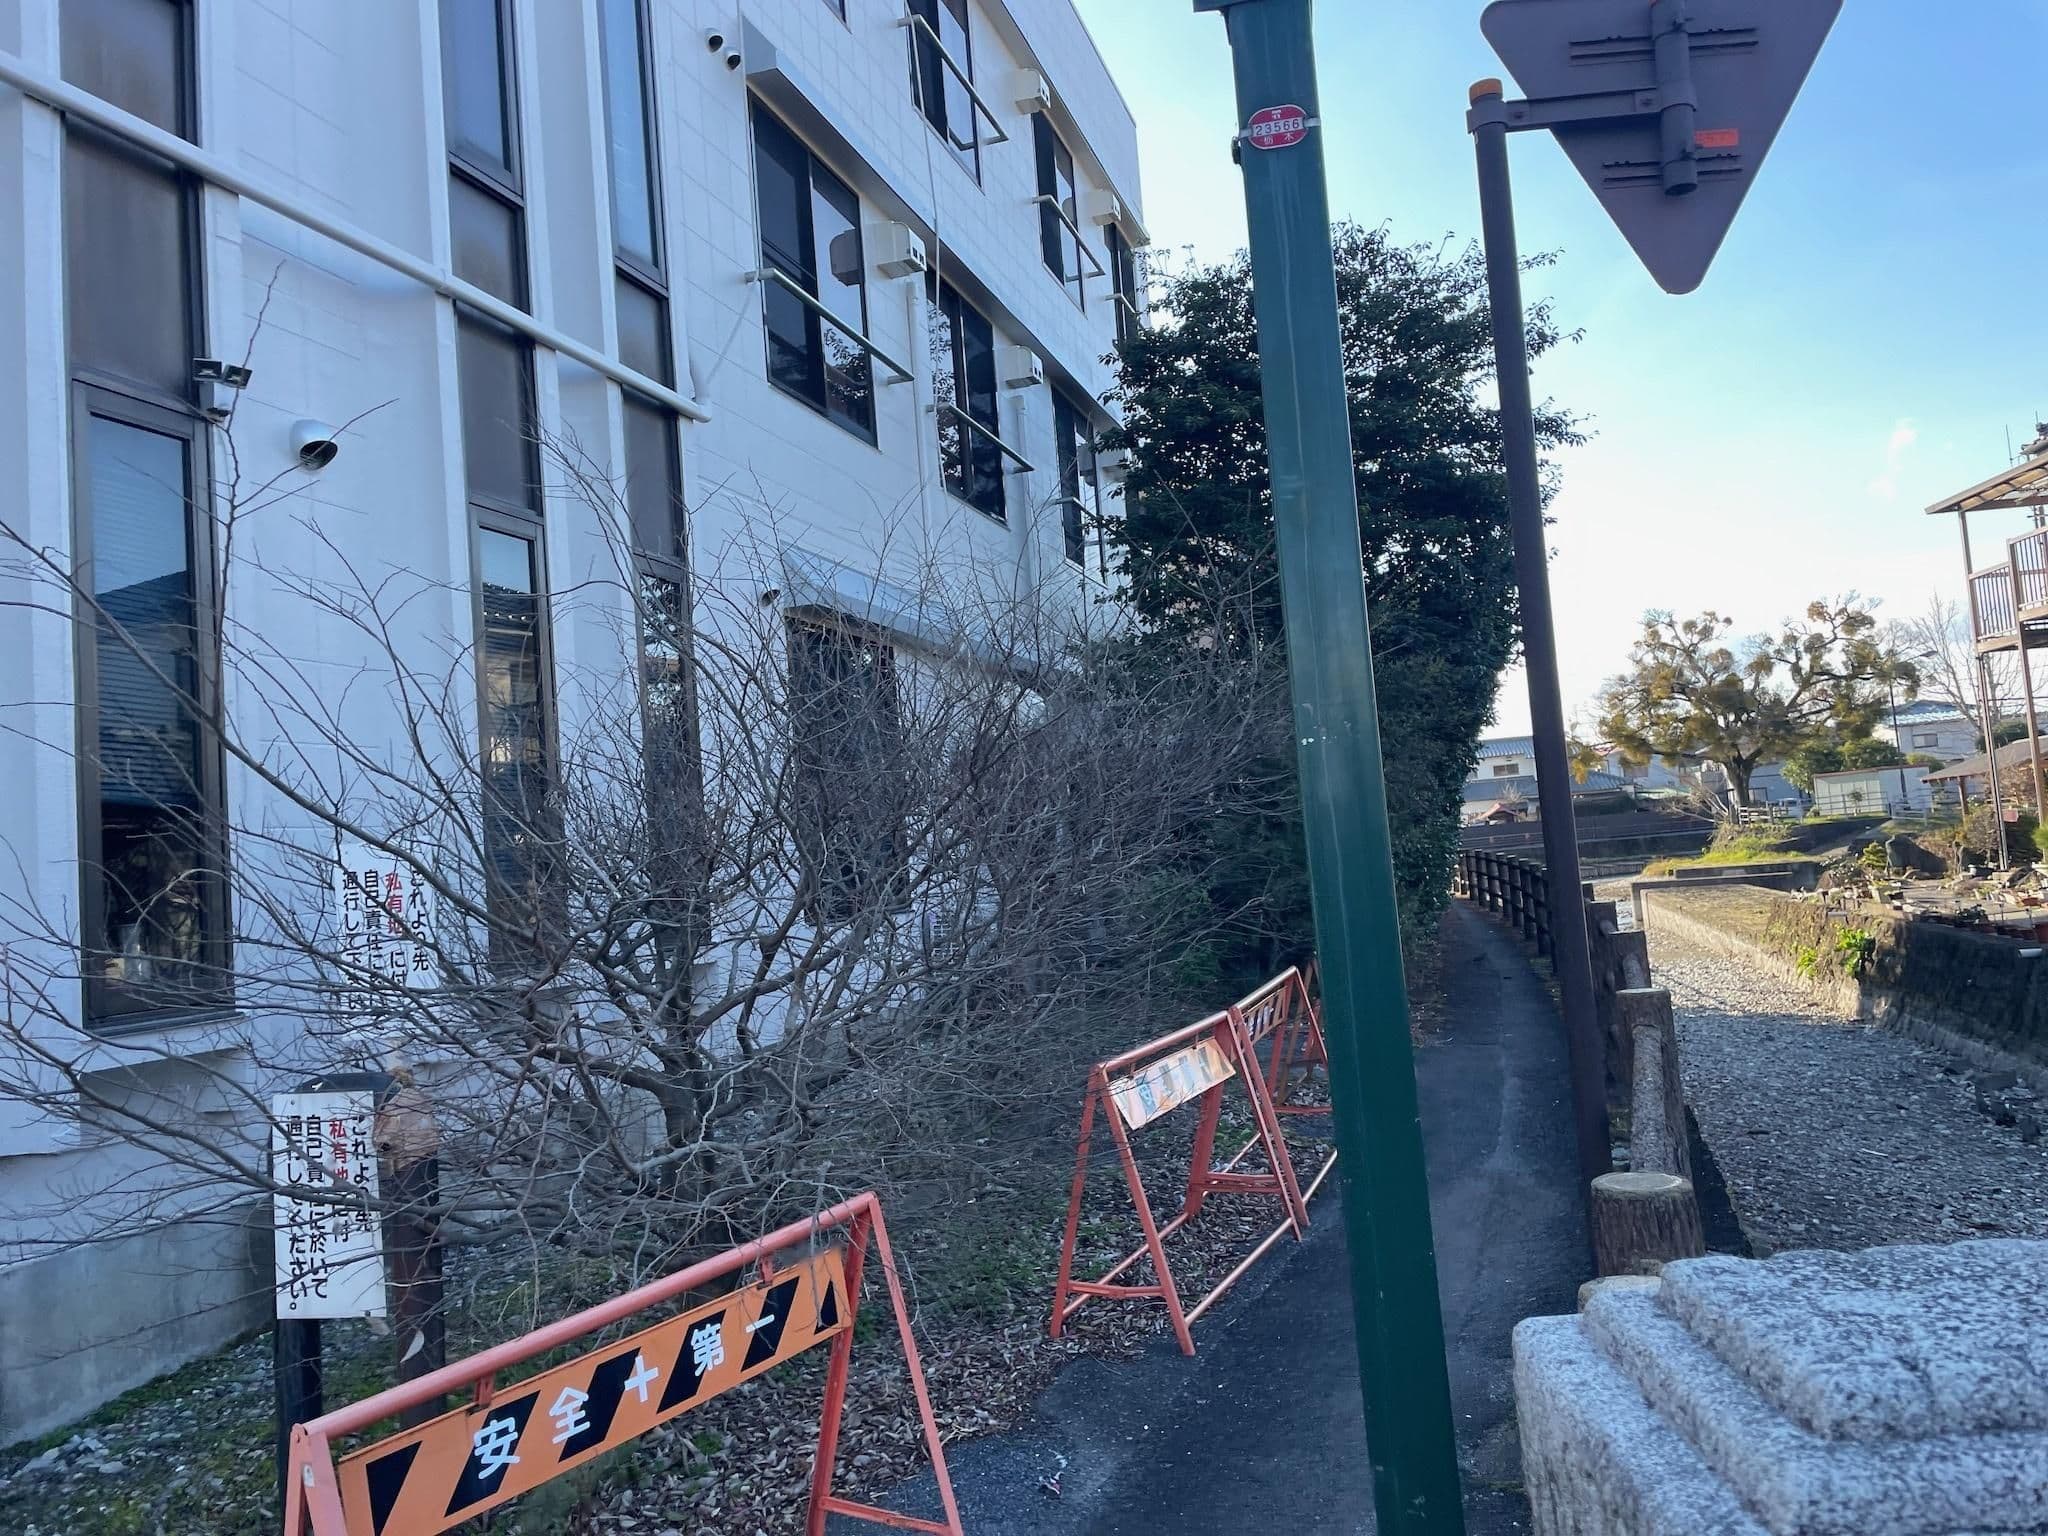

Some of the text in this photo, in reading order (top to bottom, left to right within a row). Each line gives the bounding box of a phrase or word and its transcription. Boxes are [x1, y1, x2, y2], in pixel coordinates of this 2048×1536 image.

[1256, 119, 1299, 136] 23566
[472, 1314, 775, 1481] 安全 第一
